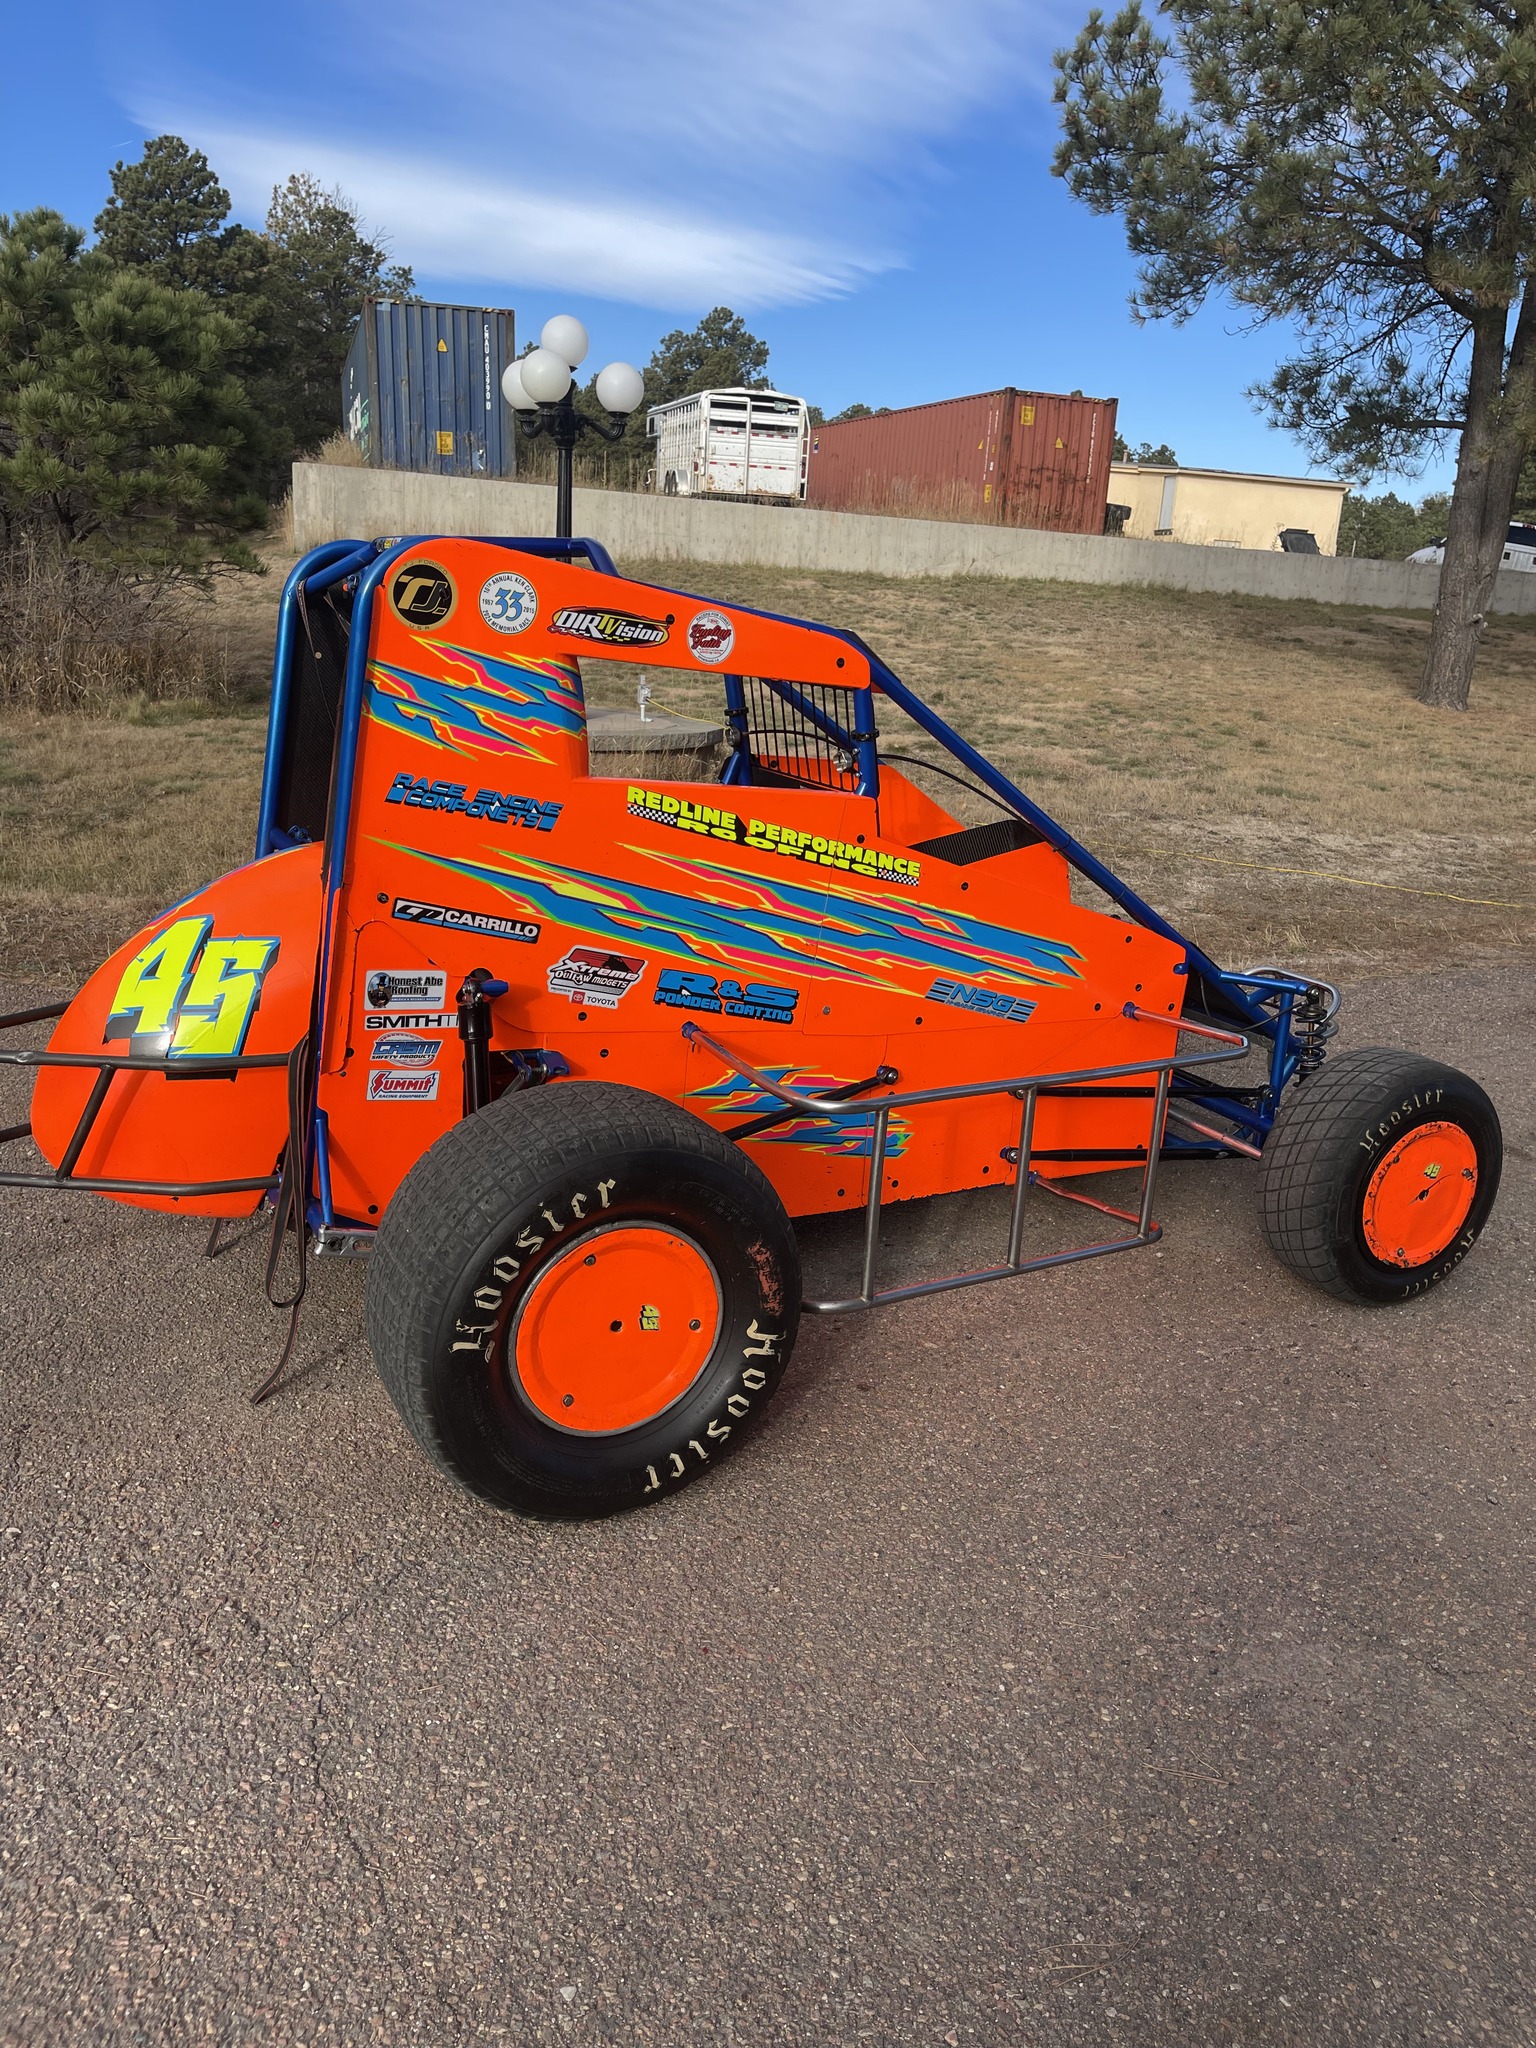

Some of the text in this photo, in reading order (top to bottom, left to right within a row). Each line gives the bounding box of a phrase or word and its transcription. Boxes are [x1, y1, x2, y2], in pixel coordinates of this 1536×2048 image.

[491, 575, 513, 586] ANNUAL
[514, 577, 526, 587] KEN
[524, 584, 536, 604] CLARK
[491, 587, 526, 622] 33
[482, 609, 531, 632] 2024 MEMORIAL RACE
[523, 606, 535, 614] 2015
[393, 772, 564, 817] RACE ENGINE
[404, 789, 541, 828] COMPONETS
[627, 785, 921, 878] REDLINE PERFORMANCE
[445, 909, 538, 938] CARRILLO
[102, 914, 281, 1058] 45
[388, 976, 443, 986] Honest Abe
[391, 986, 429, 996] Roofing
[592, 976, 628, 988] MIDGETS
[656, 968, 799, 1009] R&S
[586, 996, 616, 1007] TOYOTA
[654, 990, 794, 1022] POWDER COATING
[949, 983, 1017, 1013] NSG
[1360, 1088, 1443, 1159] Hoosier
[448, 1179, 616, 1363] Hoosier
[644, 1318, 786, 1494] Hoosier
